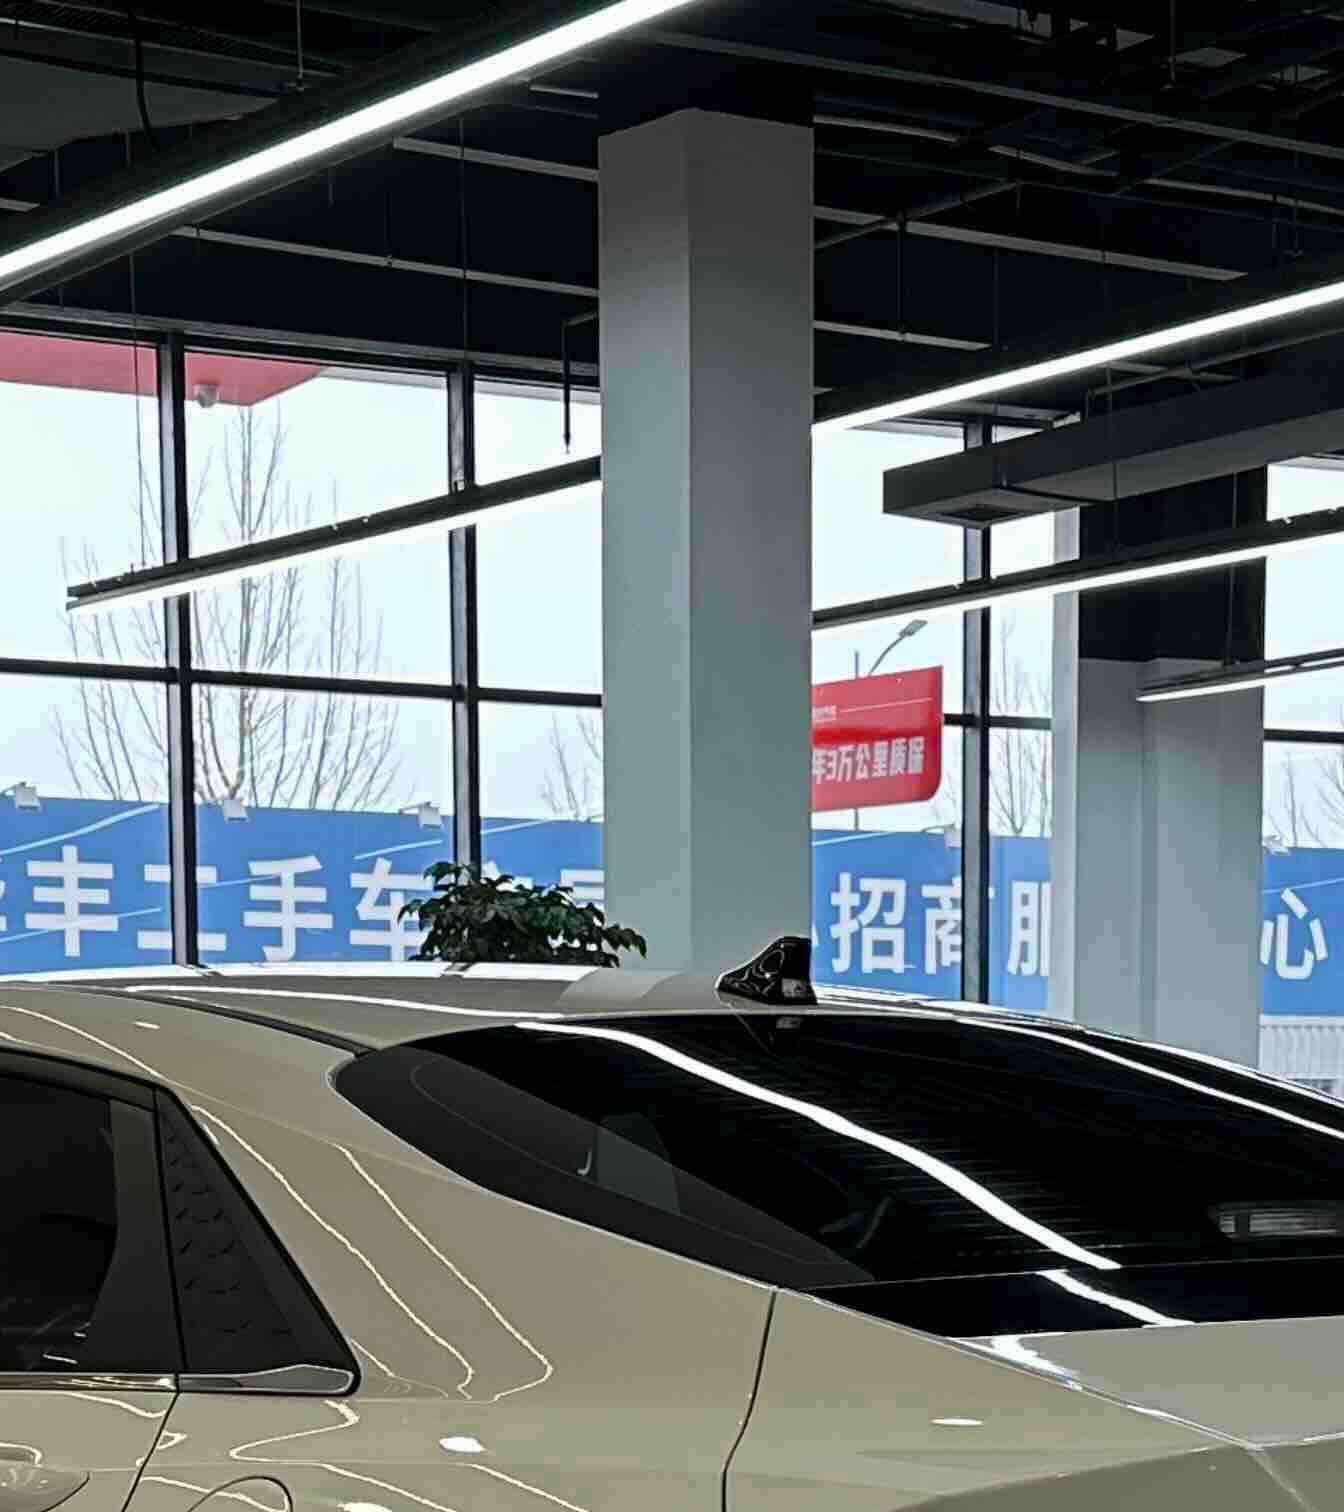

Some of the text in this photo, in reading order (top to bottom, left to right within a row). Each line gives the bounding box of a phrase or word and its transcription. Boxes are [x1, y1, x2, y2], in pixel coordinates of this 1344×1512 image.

[812, 736, 924, 784] 年3万公里质保
